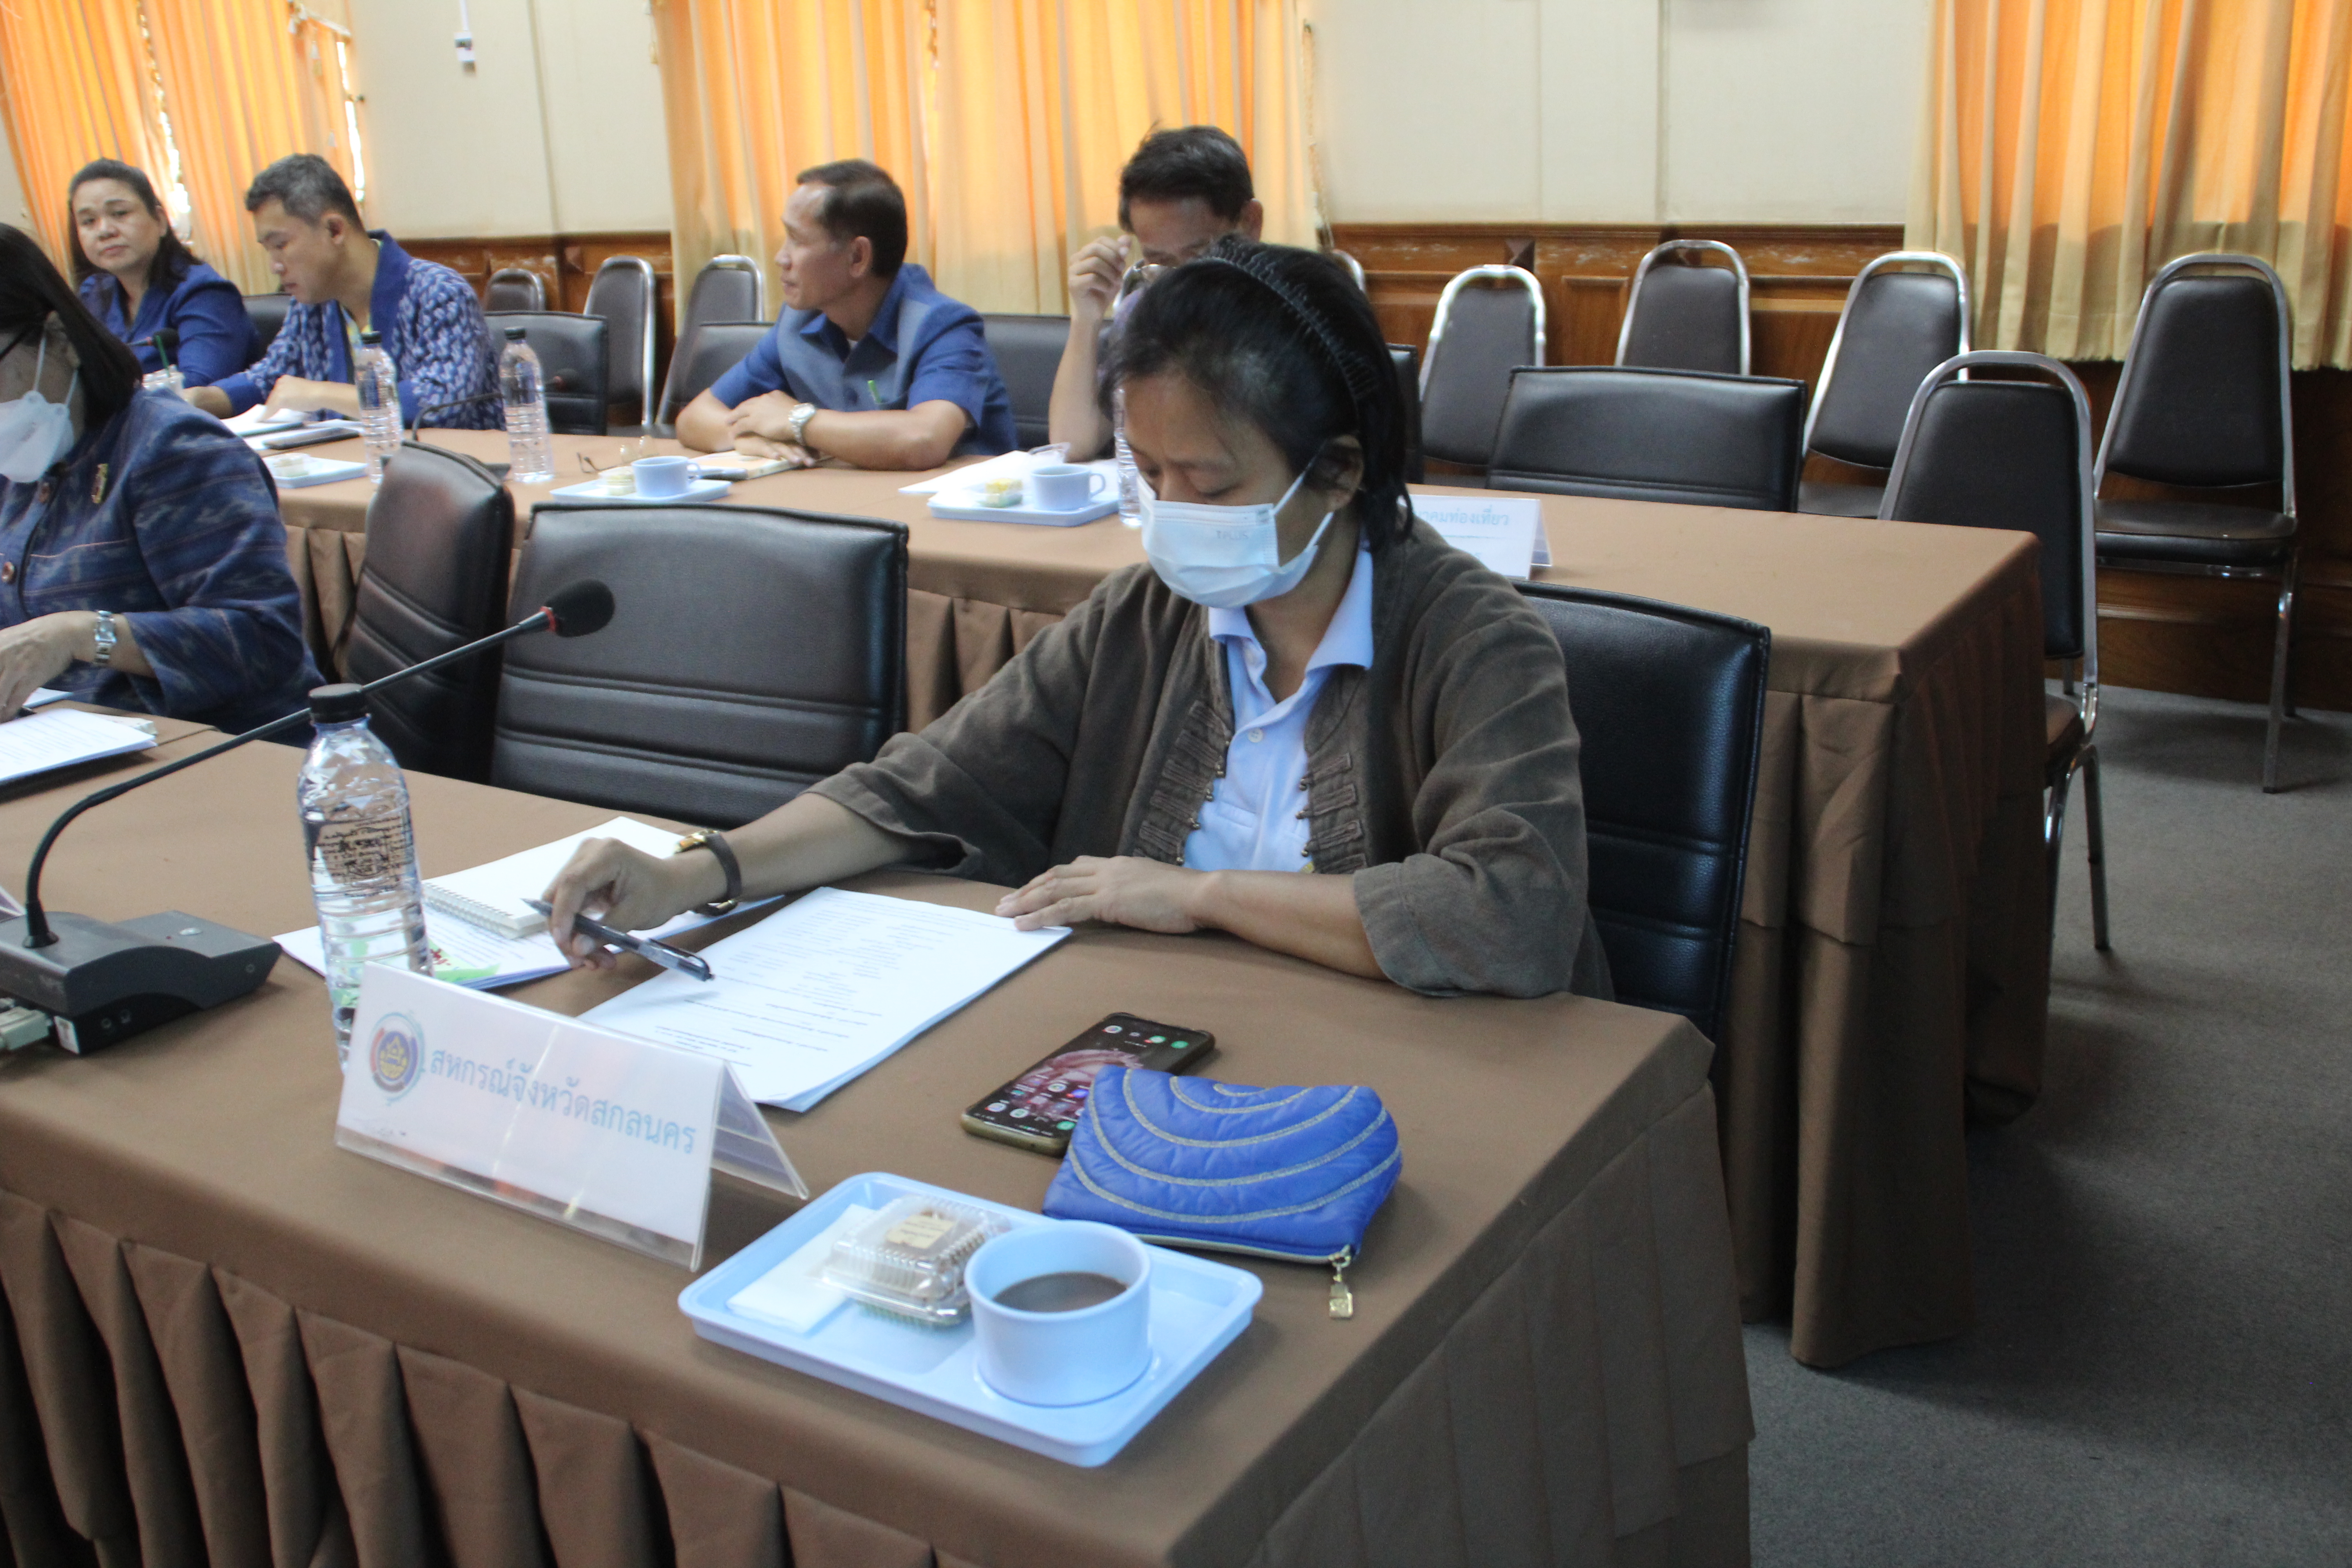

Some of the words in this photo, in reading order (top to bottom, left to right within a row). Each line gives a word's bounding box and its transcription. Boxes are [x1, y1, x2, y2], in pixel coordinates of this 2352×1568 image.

[430, 1049, 696, 1155] สหกรณ์จังหวัดสกลนคร
